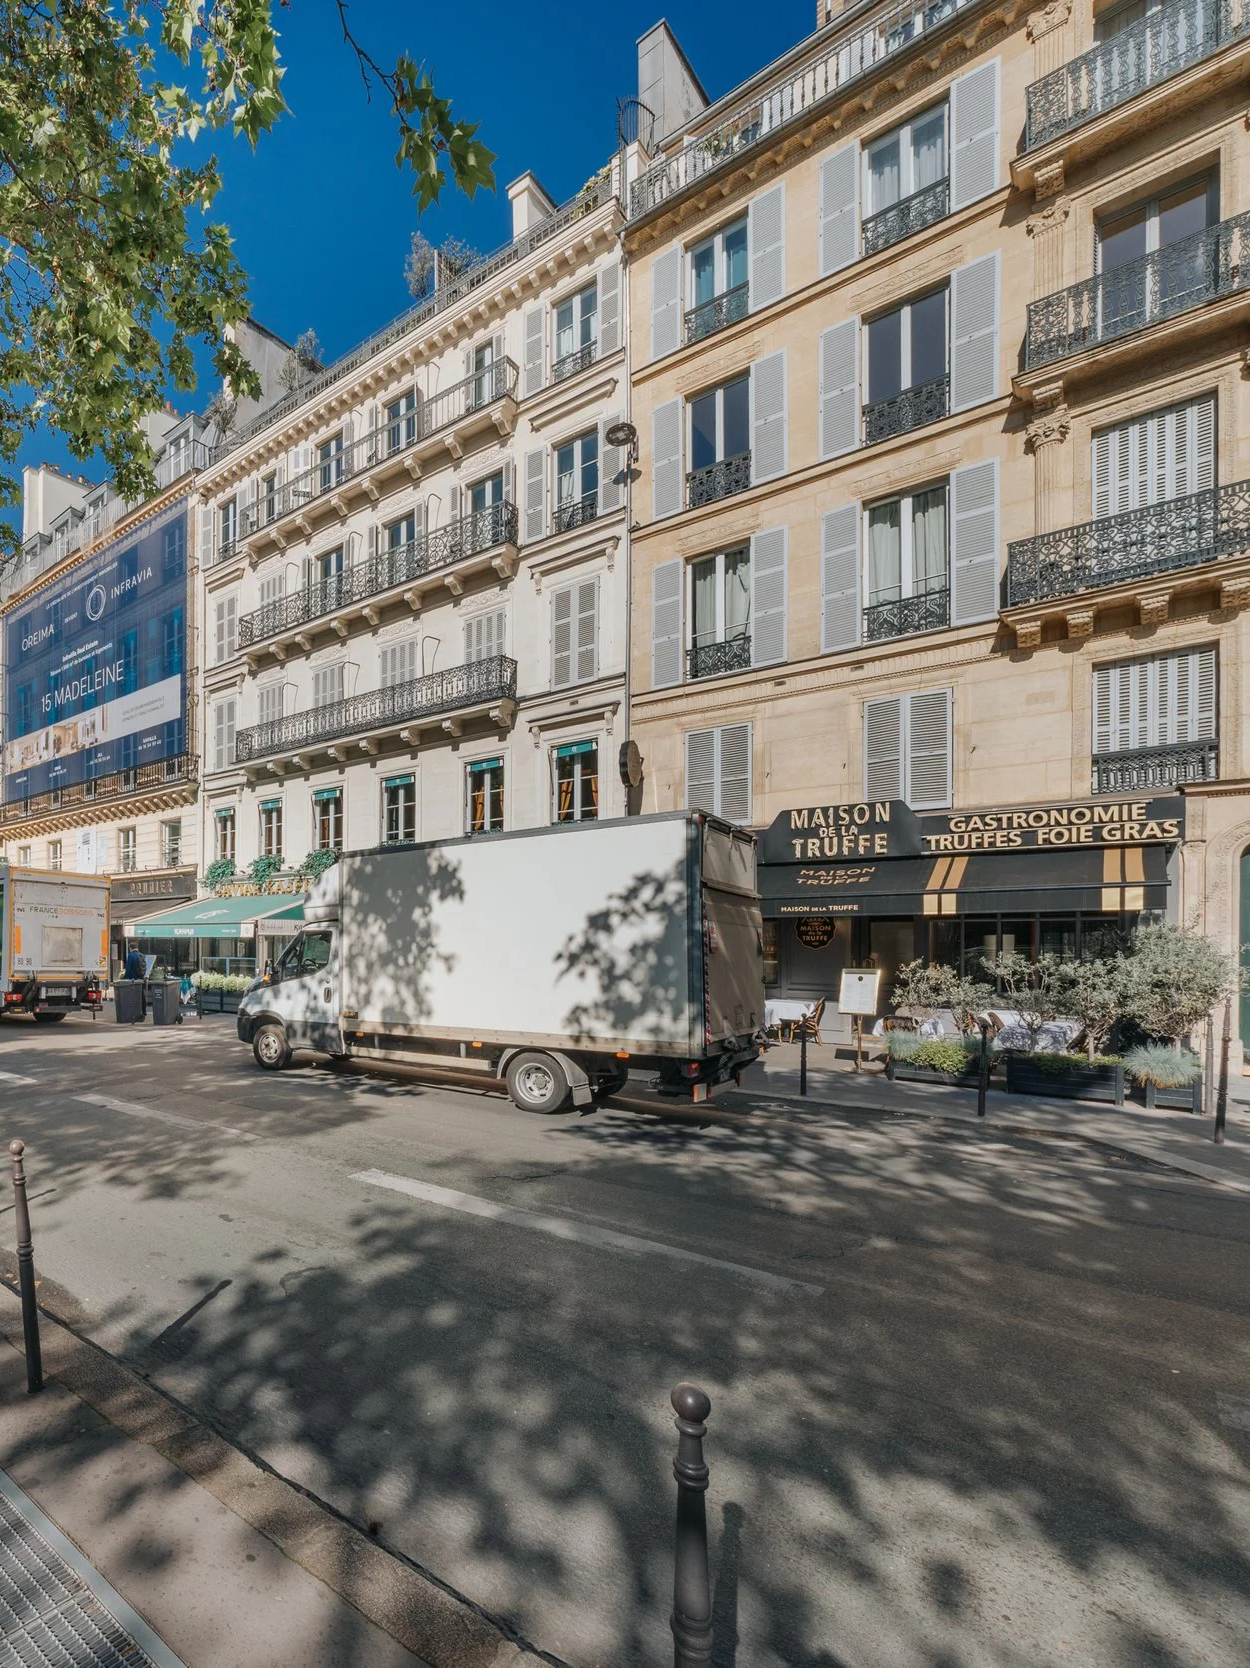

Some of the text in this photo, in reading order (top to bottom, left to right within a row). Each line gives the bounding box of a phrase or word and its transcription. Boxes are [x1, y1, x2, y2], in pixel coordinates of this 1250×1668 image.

[111, 566, 152, 600] INFRAVIA
[22, 623, 54, 651] OREIMA
[42, 660, 124, 712] 15 MADELEINE
[790, 802, 890, 830] MAISON
[949, 802, 1147, 833] GASTRONOMIE
[819, 825, 858, 838] DE LA
[926, 820, 1180, 851] TRUFFES FOIE GRAS
[792, 833, 888, 858] TRUFFE
[796, 876, 871, 885] TRUFFE
[800, 866, 876, 876] MAISON
[266, 878, 310, 895] KASPI
[30, 906, 94, 916] FRANCE BOISSONS
